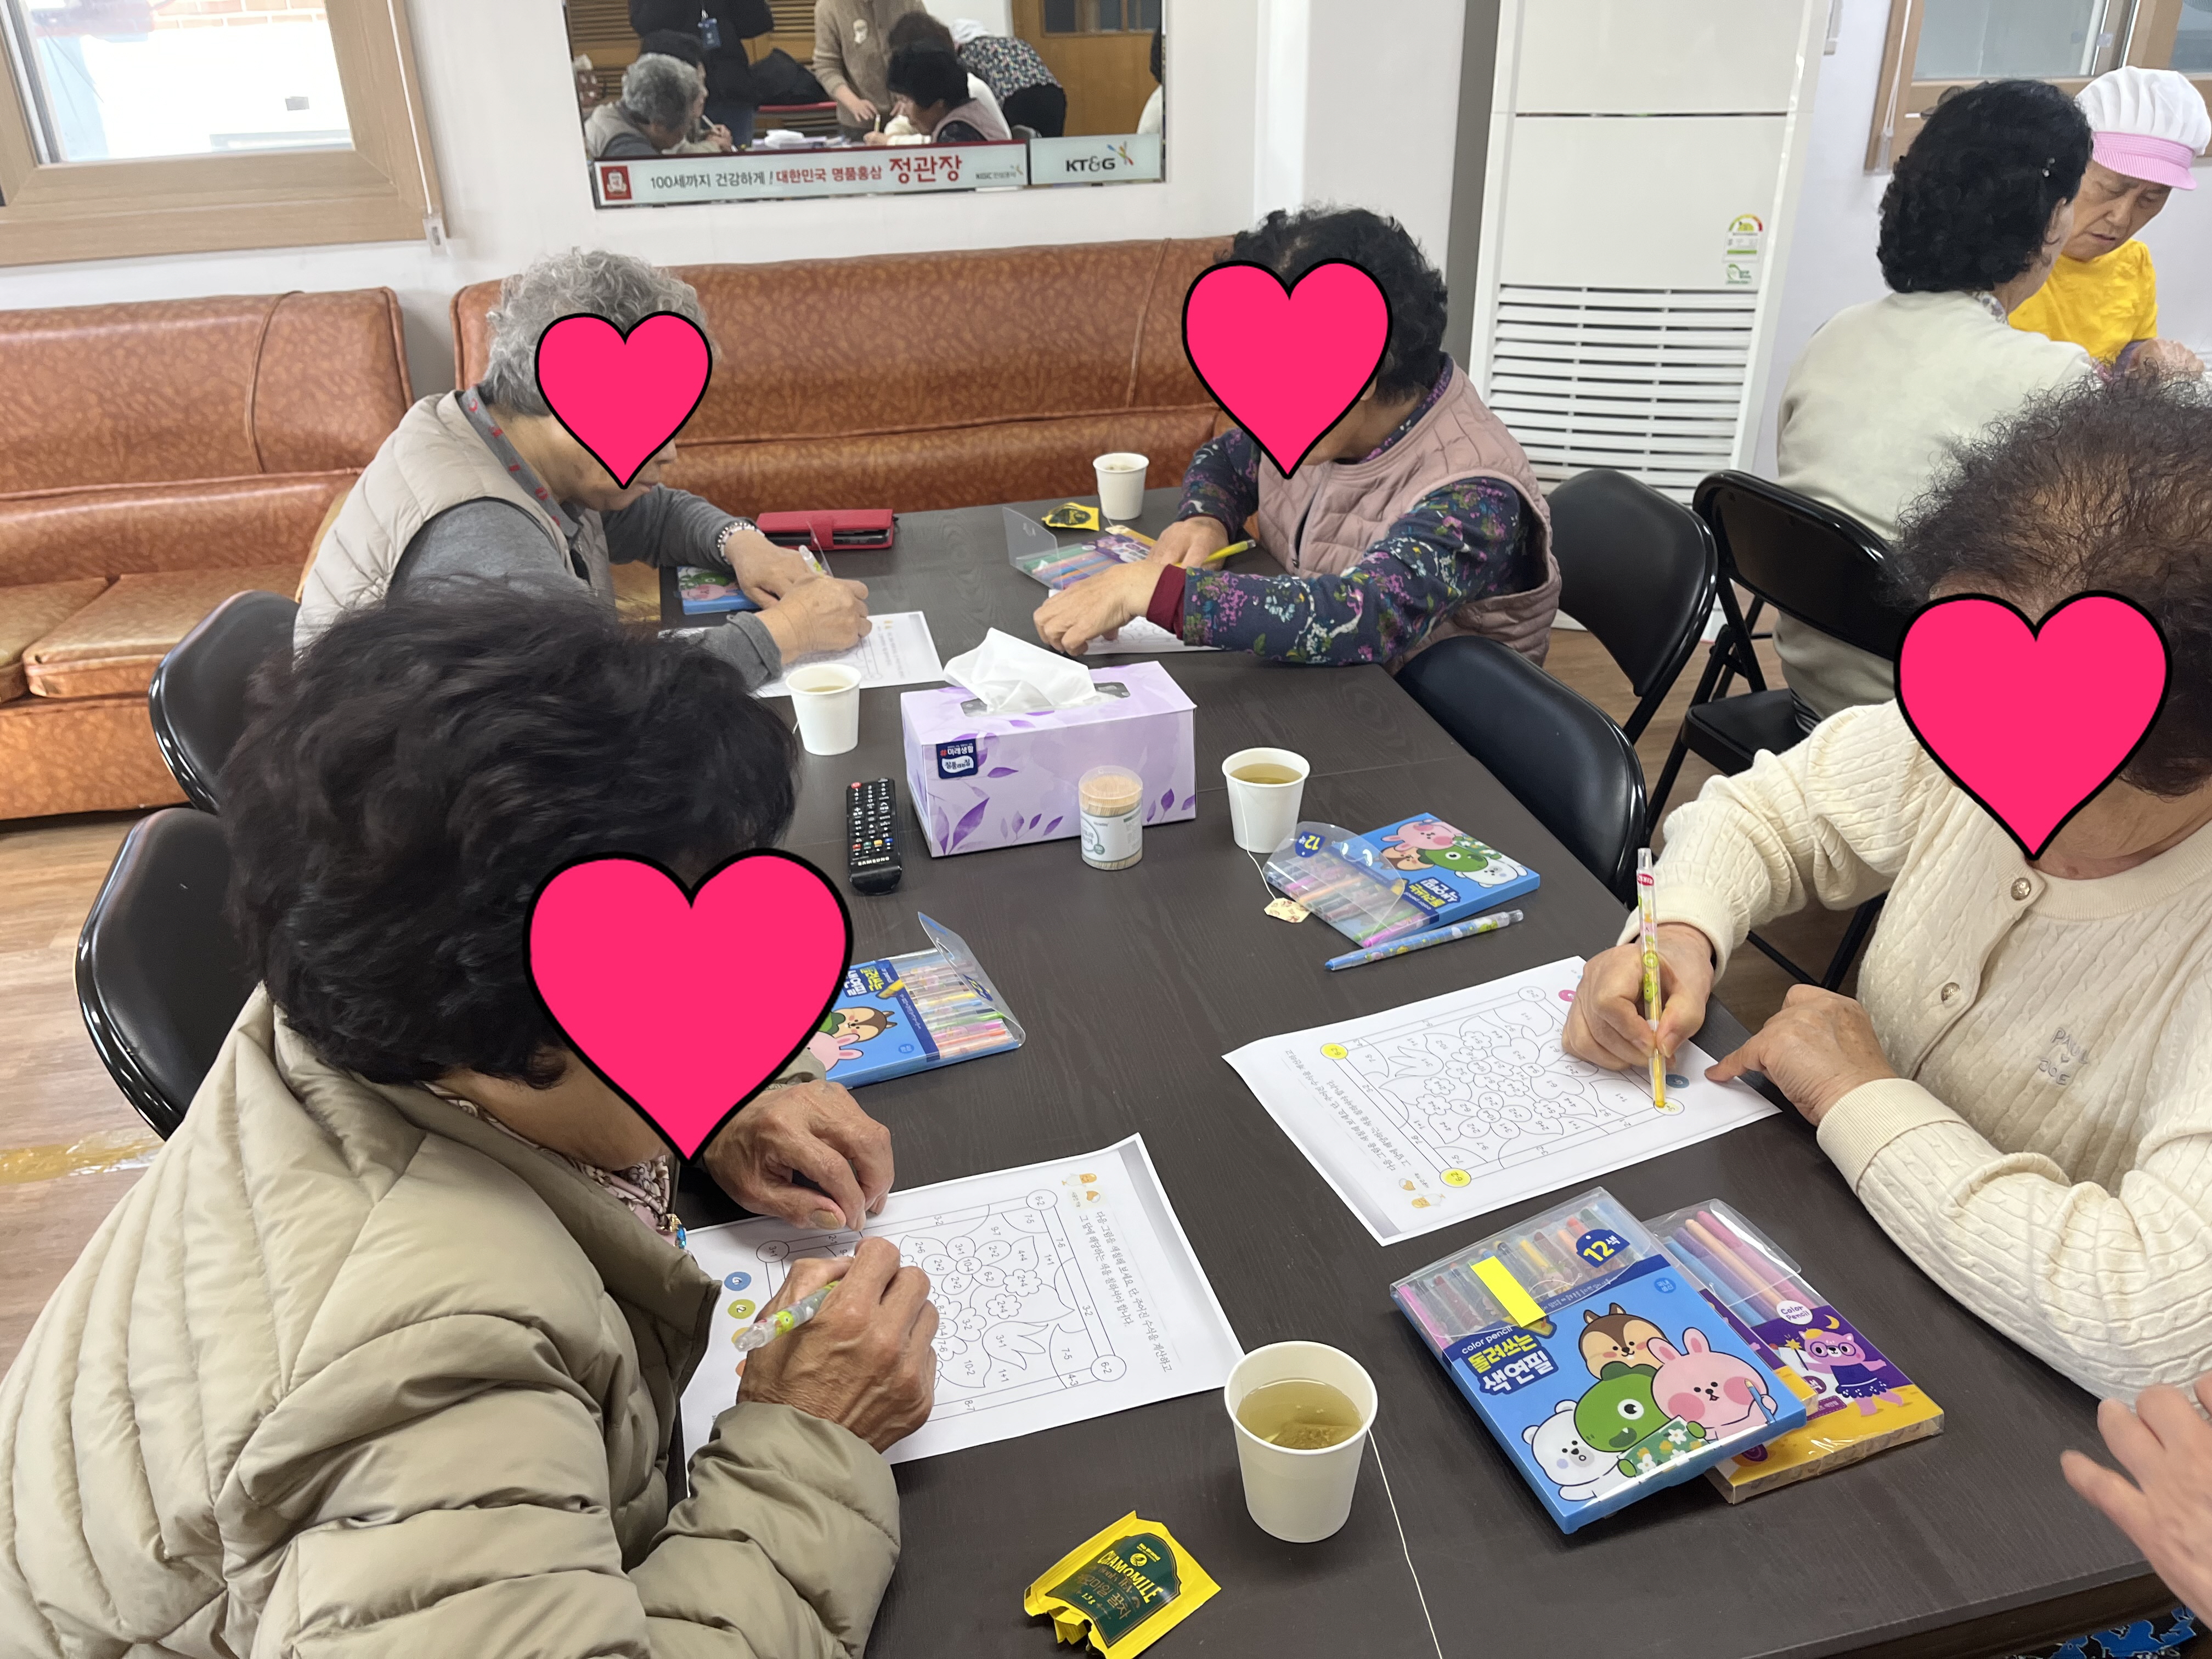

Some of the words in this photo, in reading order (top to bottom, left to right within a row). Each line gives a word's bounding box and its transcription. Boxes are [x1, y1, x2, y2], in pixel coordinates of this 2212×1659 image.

[1066, 156, 1115, 172] KT&G
[651, 173, 711, 189] 100세까지
[715, 171, 766, 187] 건강하게
[776, 167, 827, 184] 대한민국
[832, 165, 883, 182] 명품홍삼
[889, 155, 963, 184] 정관장
[858, 856, 890, 866] SAMSUNG
[1420, 878, 1458, 902] 색연필
[2050, 1027, 2089, 1064] PAUL
[1285, 1049, 1306, 1070] 계산하고
[1302, 1070, 1318, 1086] 수식을
[2038, 1058, 2070, 1086] JOE
[1315, 1086, 1331, 1102] 주어진
[1509, 1108, 1522, 1119] 2+2
[1360, 1115, 1372, 1127] 색을
[1351, 1125, 1369, 1142] 색칠해
[1467, 1123, 1480, 1133] 2+2
[1371, 1127, 1392, 1149] 해당하는
[1367, 1142, 1386, 1159] 그림을
[1389, 1148, 1404, 1161] 답에
[1383, 1158, 1396, 1171] 다음
[1451, 1172, 1463, 1182] 6-2
[1035, 1196, 1045, 1206] 6-2
[934, 1215, 944, 1226] 3-2
[1024, 1214, 1035, 1224] 7-5
[1096, 1211, 1107, 1224] 다음
[991, 1226, 1001, 1236] 9-7
[1082, 1222, 1096, 1235] 답에
[1101, 1225, 1116, 1244] 그림을
[828, 1235, 838, 1245] 2-1
[1056, 1238, 1066, 1248] 7-6
[769, 1245, 777, 1257] 3+1
[915, 1242, 926, 1254] 2+6
[955, 1243, 965, 1255] 3+1
[989, 1245, 1000, 1258] 2+2
[1088, 1235, 1105, 1262] 해당하는
[1018, 1250, 1028, 1262] 4+4
[1044, 1254, 1054, 1266] 1+1
[1110, 1245, 1126, 1265] 색칠해
[934, 1259, 945, 1272] 2+2
[963, 1259, 974, 1272] 10-4
[1100, 1263, 1111, 1276] 색을
[951, 1277, 962, 1289] 2+2
[984, 1271, 994, 1282] 6-2
[1017, 1274, 1028, 1287] 2+4
[1105, 1277, 1125, 1303] 칠하셔야
[936, 1305, 946, 1316] 8-7
[997, 1300, 1008, 1313] 2+4
[1082, 1305, 1093, 1316] 3-2
[1133, 1298, 1150, 1318] 주어진
[1781, 1306, 1803, 1314] Color
[1116, 1304, 1134, 1327] 합니다.
[1786, 1310, 1810, 1321] Pencil
[962, 1318, 973, 1330] 3-2
[1142, 1320, 1159, 1341] 수식을
[937, 1340, 948, 1352] 7-6
[996, 1334, 1007, 1348] 3+1
[1462, 1339, 1484, 1355] color
[1485, 1327, 1513, 1344] pencil
[1062, 1347, 1073, 1360] 7-5
[1153, 1342, 1172, 1373] 계산하고
[1468, 1334, 1537, 1373] 돌려쓰는
[963, 1359, 975, 1376] 10-2
[1101, 1362, 1112, 1374] 6-2
[1482, 1350, 1554, 1392] 색연필
[998, 1369, 1009, 1382] 1+1
[1068, 1374, 1079, 1386] 4-3
[964, 1400, 975, 1412] 8-7
[1097, 1550, 1164, 1604] CHAMOMILE
[1107, 1592, 1131, 1620] 꿀차
